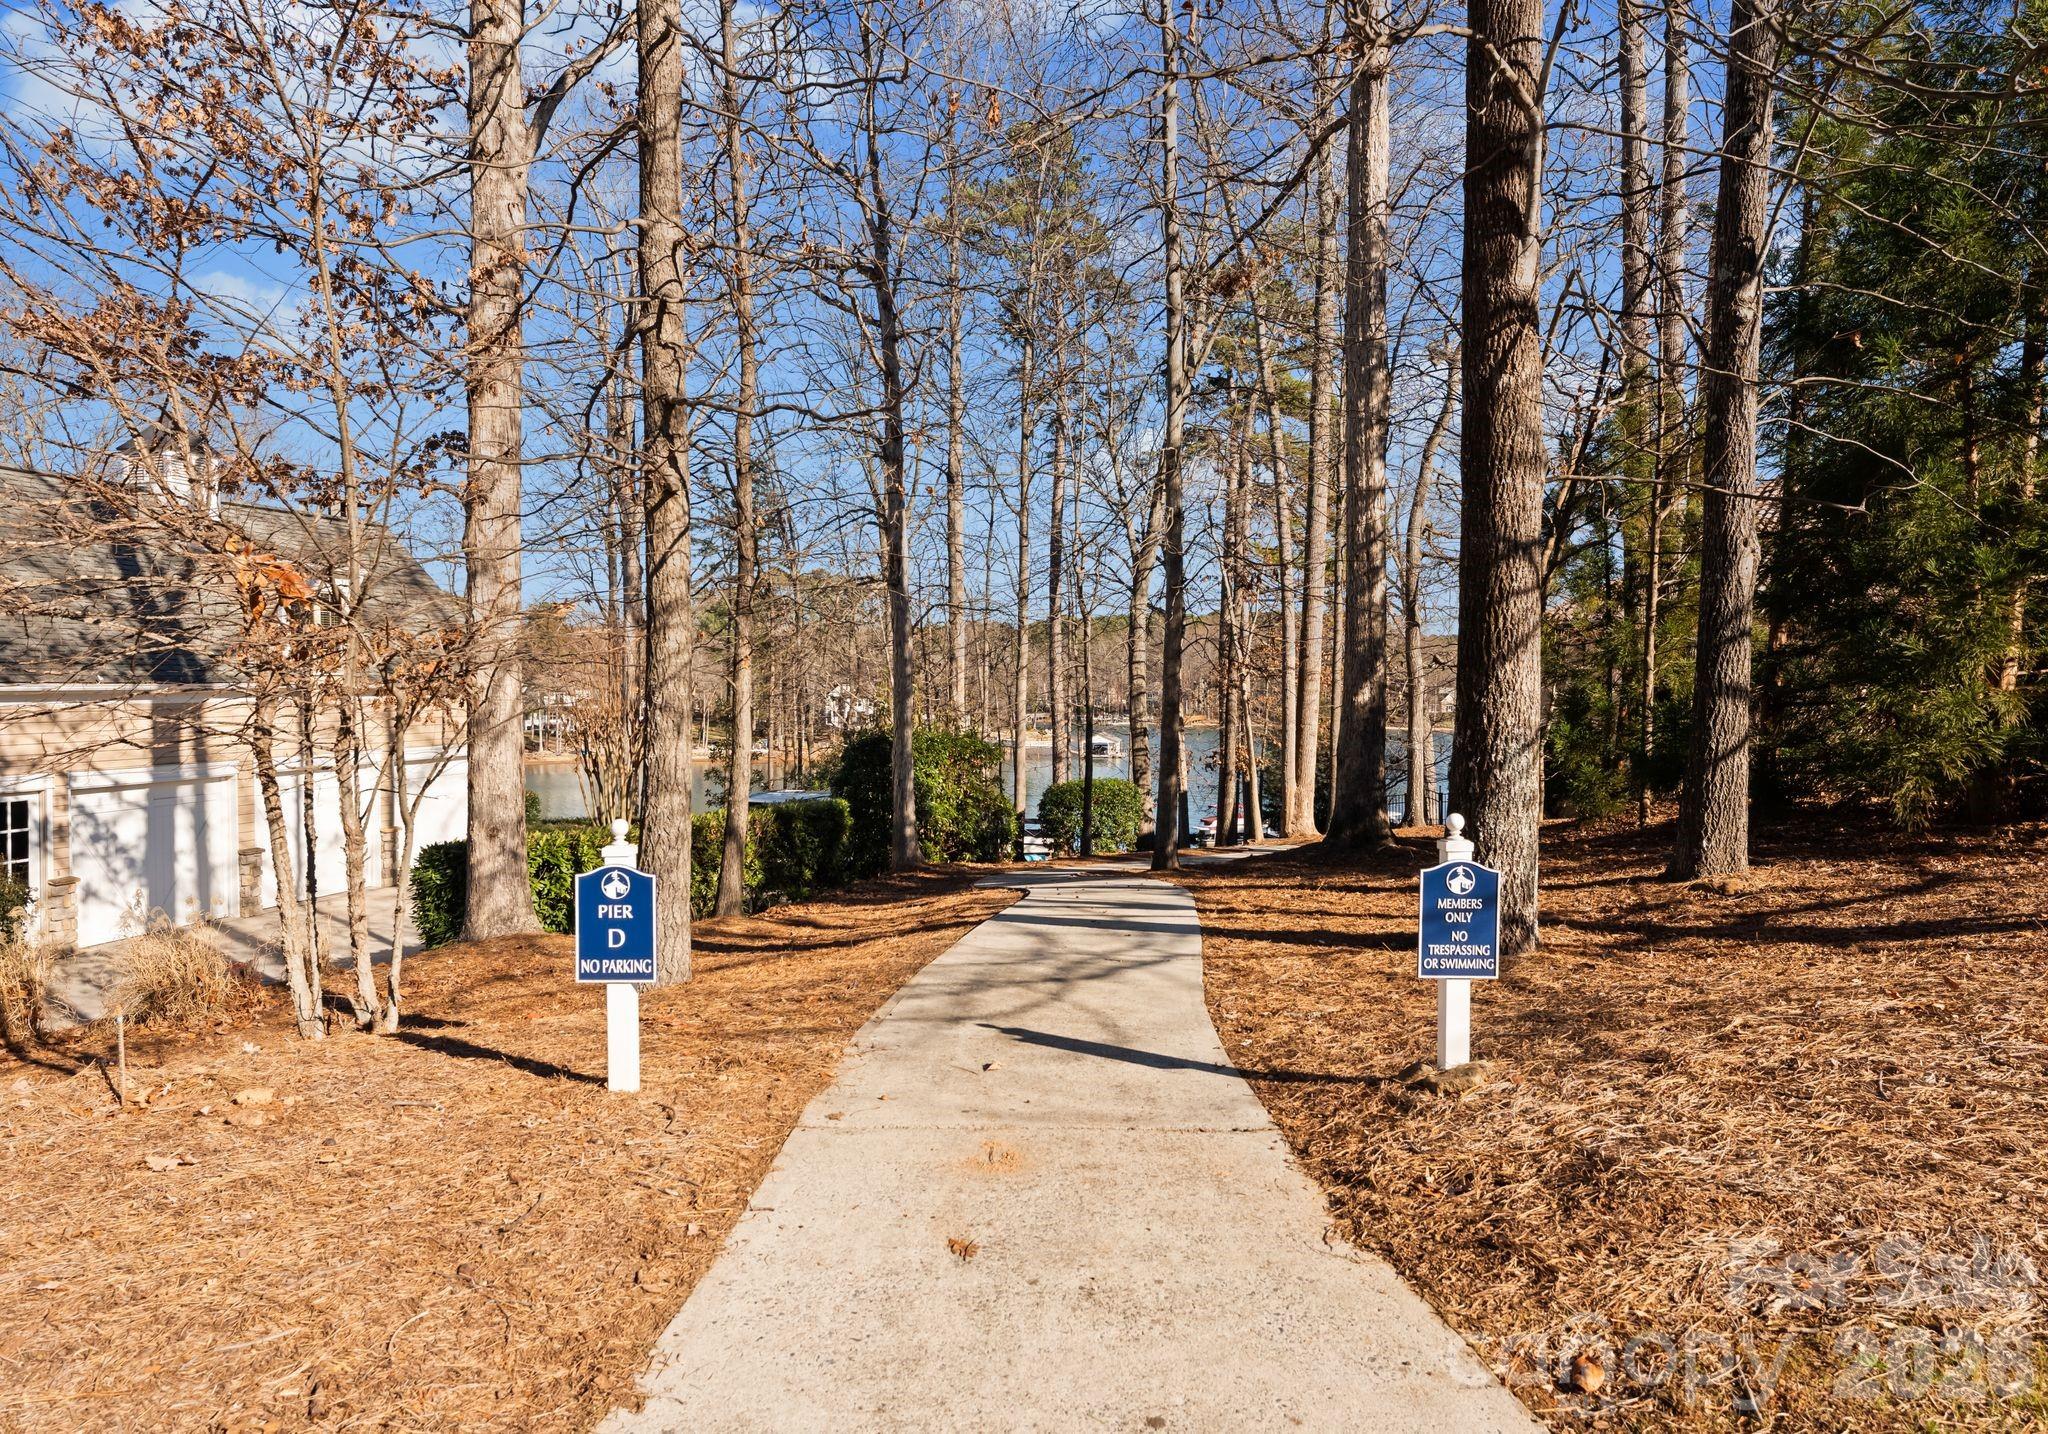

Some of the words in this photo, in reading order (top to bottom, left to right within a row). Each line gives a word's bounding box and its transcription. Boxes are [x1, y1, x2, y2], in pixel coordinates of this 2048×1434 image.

[1437, 898, 1482, 910] MEMBERS
[598, 904, 633, 919] PIER
[1445, 912, 1473, 923] ONLY
[608, 928, 625, 948] D
[1451, 930, 1468, 942] NO
[1428, 944, 1491, 956] TRESPASSING
[581, 959, 600, 974] NO
[602, 959, 652, 974] PARKING
[1424, 958, 1439, 969] OR
[1440, 958, 1495, 970] SWIMMING
